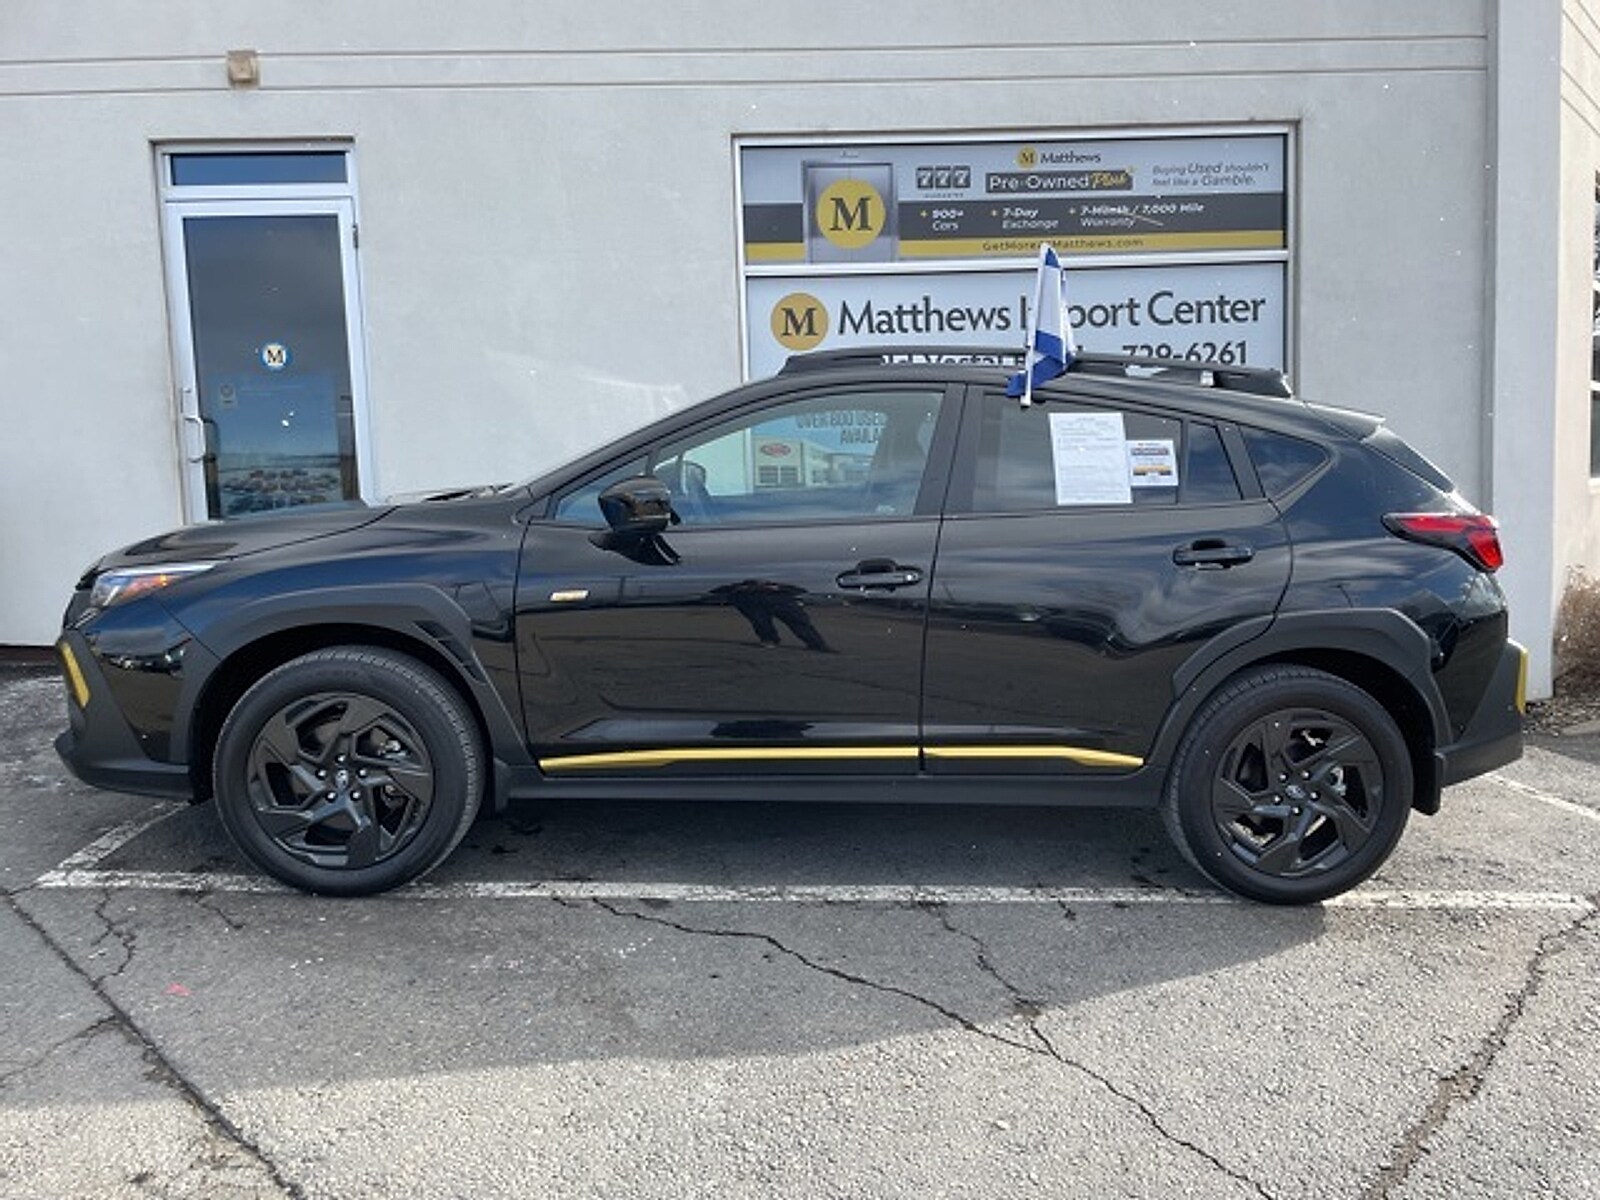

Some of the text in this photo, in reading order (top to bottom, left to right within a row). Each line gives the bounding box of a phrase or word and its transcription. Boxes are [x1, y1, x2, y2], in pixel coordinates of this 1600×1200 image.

[1040, 150, 1102, 164] Matthews
[1187, 160, 1221, 174] Used
[989, 174, 1089, 190] Pre-Owned
[829, 197, 873, 231] M
[1002, 207, 1039, 218] 7-Day
[932, 220, 959, 231] Cars
[1002, 219, 1059, 230] Exchange
[1080, 217, 1136, 229] Warranty
[982, 238, 1144, 251] GetMoreMatthews.com
[838, 290, 1266, 335] Matthews Iport Center
[781, 306, 819, 337] M
[267, 349, 283, 363] M
